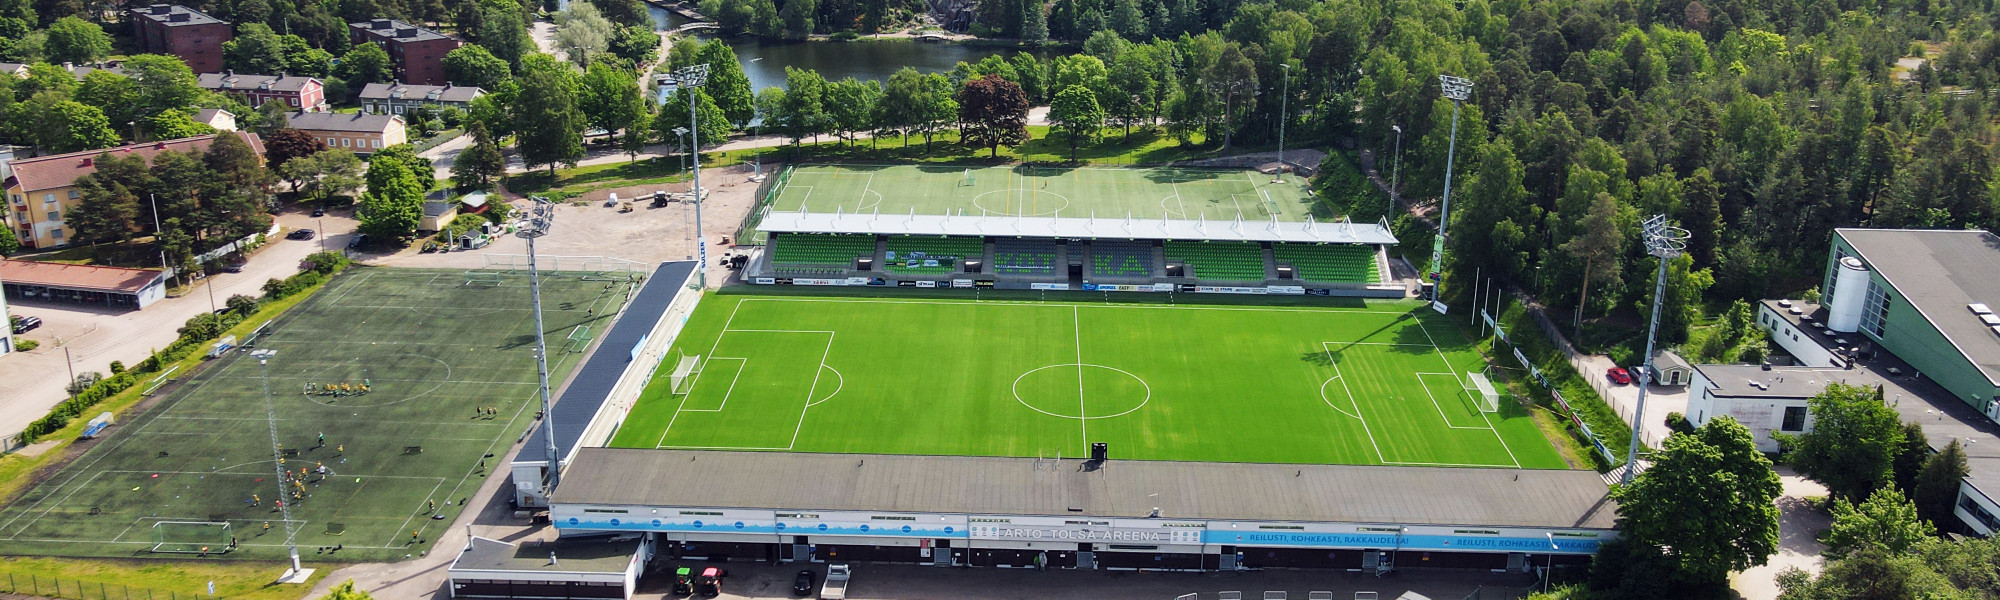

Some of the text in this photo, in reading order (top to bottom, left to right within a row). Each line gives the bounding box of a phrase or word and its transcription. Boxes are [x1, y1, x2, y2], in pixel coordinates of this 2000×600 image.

[1095, 255, 1148, 275] KA
[1004, 528, 1042, 539] ARTO
[1050, 528, 1096, 540] TOLSA
[1102, 530, 1160, 541] AREENA
[1249, 534, 1289, 543] REILUSTI,
[1291, 535, 1342, 544] ROHKEASTI,
[1456, 539, 1496, 548] REILUSTI,
[1499, 540, 1551, 549] ROHKEASTI,
